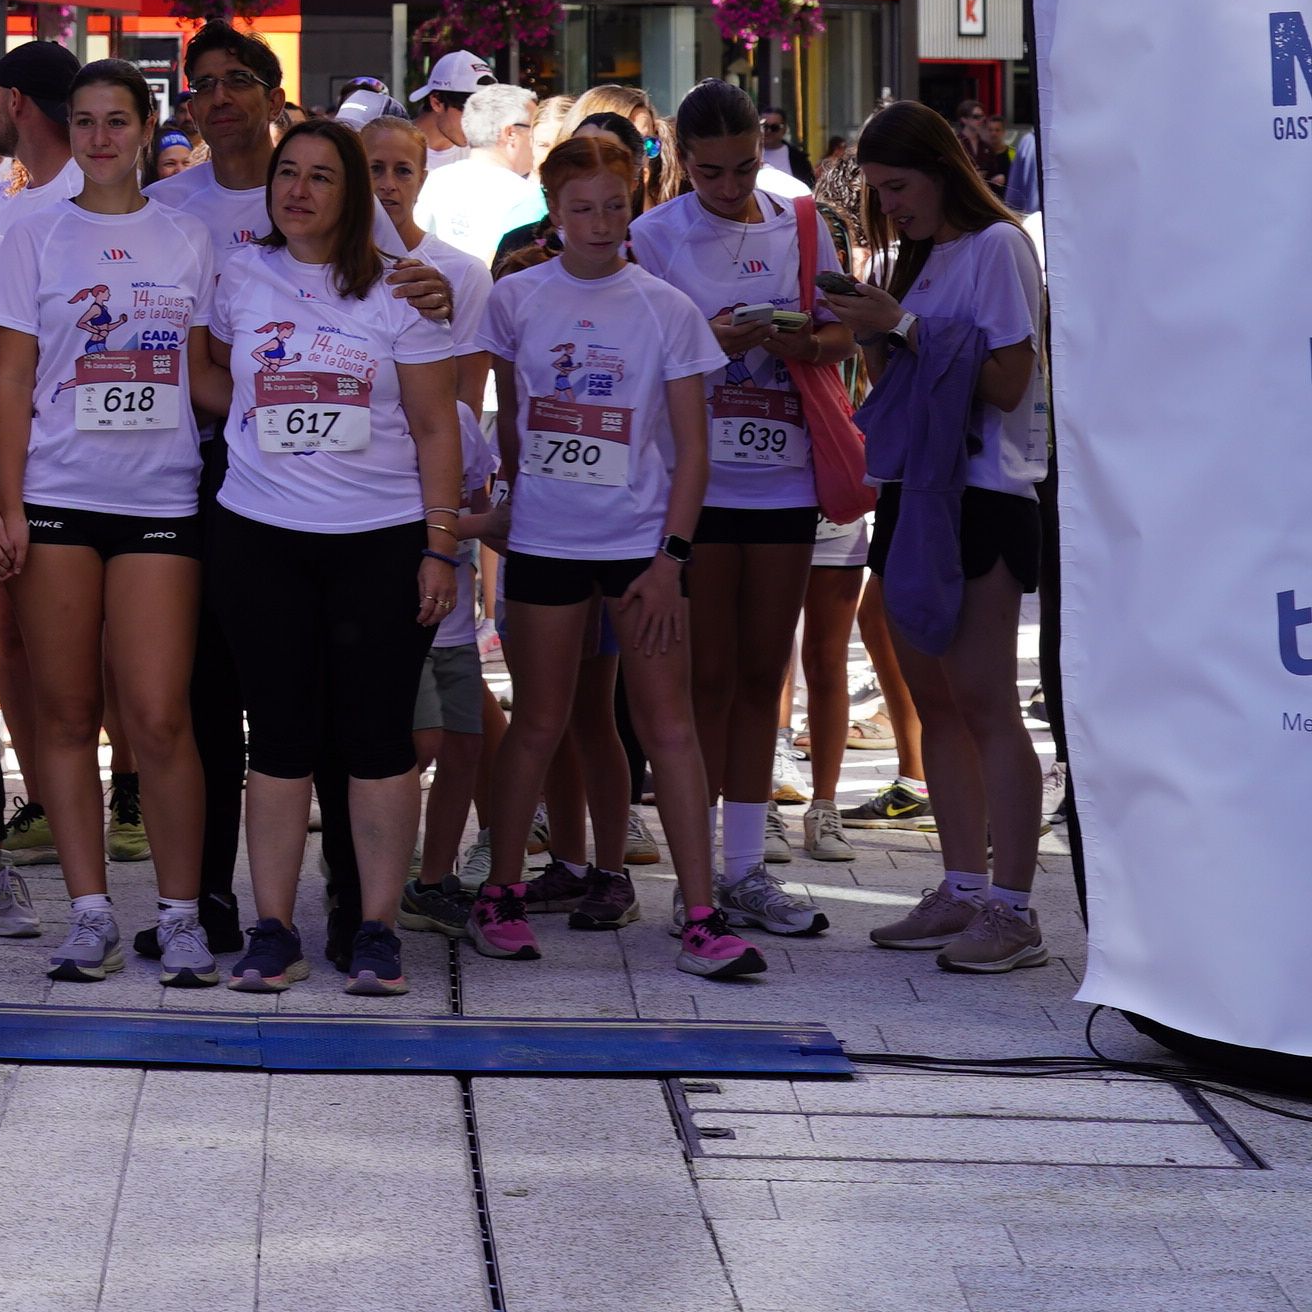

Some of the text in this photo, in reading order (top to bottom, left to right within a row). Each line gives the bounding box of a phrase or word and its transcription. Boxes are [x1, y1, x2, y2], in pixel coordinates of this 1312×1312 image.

[142, 330, 178, 341] CADA
[308, 352, 364, 373] de la Dona
[336, 343, 368, 361] Cursa
[104, 386, 154, 412] 618
[286, 408, 341, 437] 617
[739, 422, 787, 453] 639
[544, 439, 601, 466] 780
[28, 519, 64, 530] NIKE
[143, 531, 177, 540] PRO
